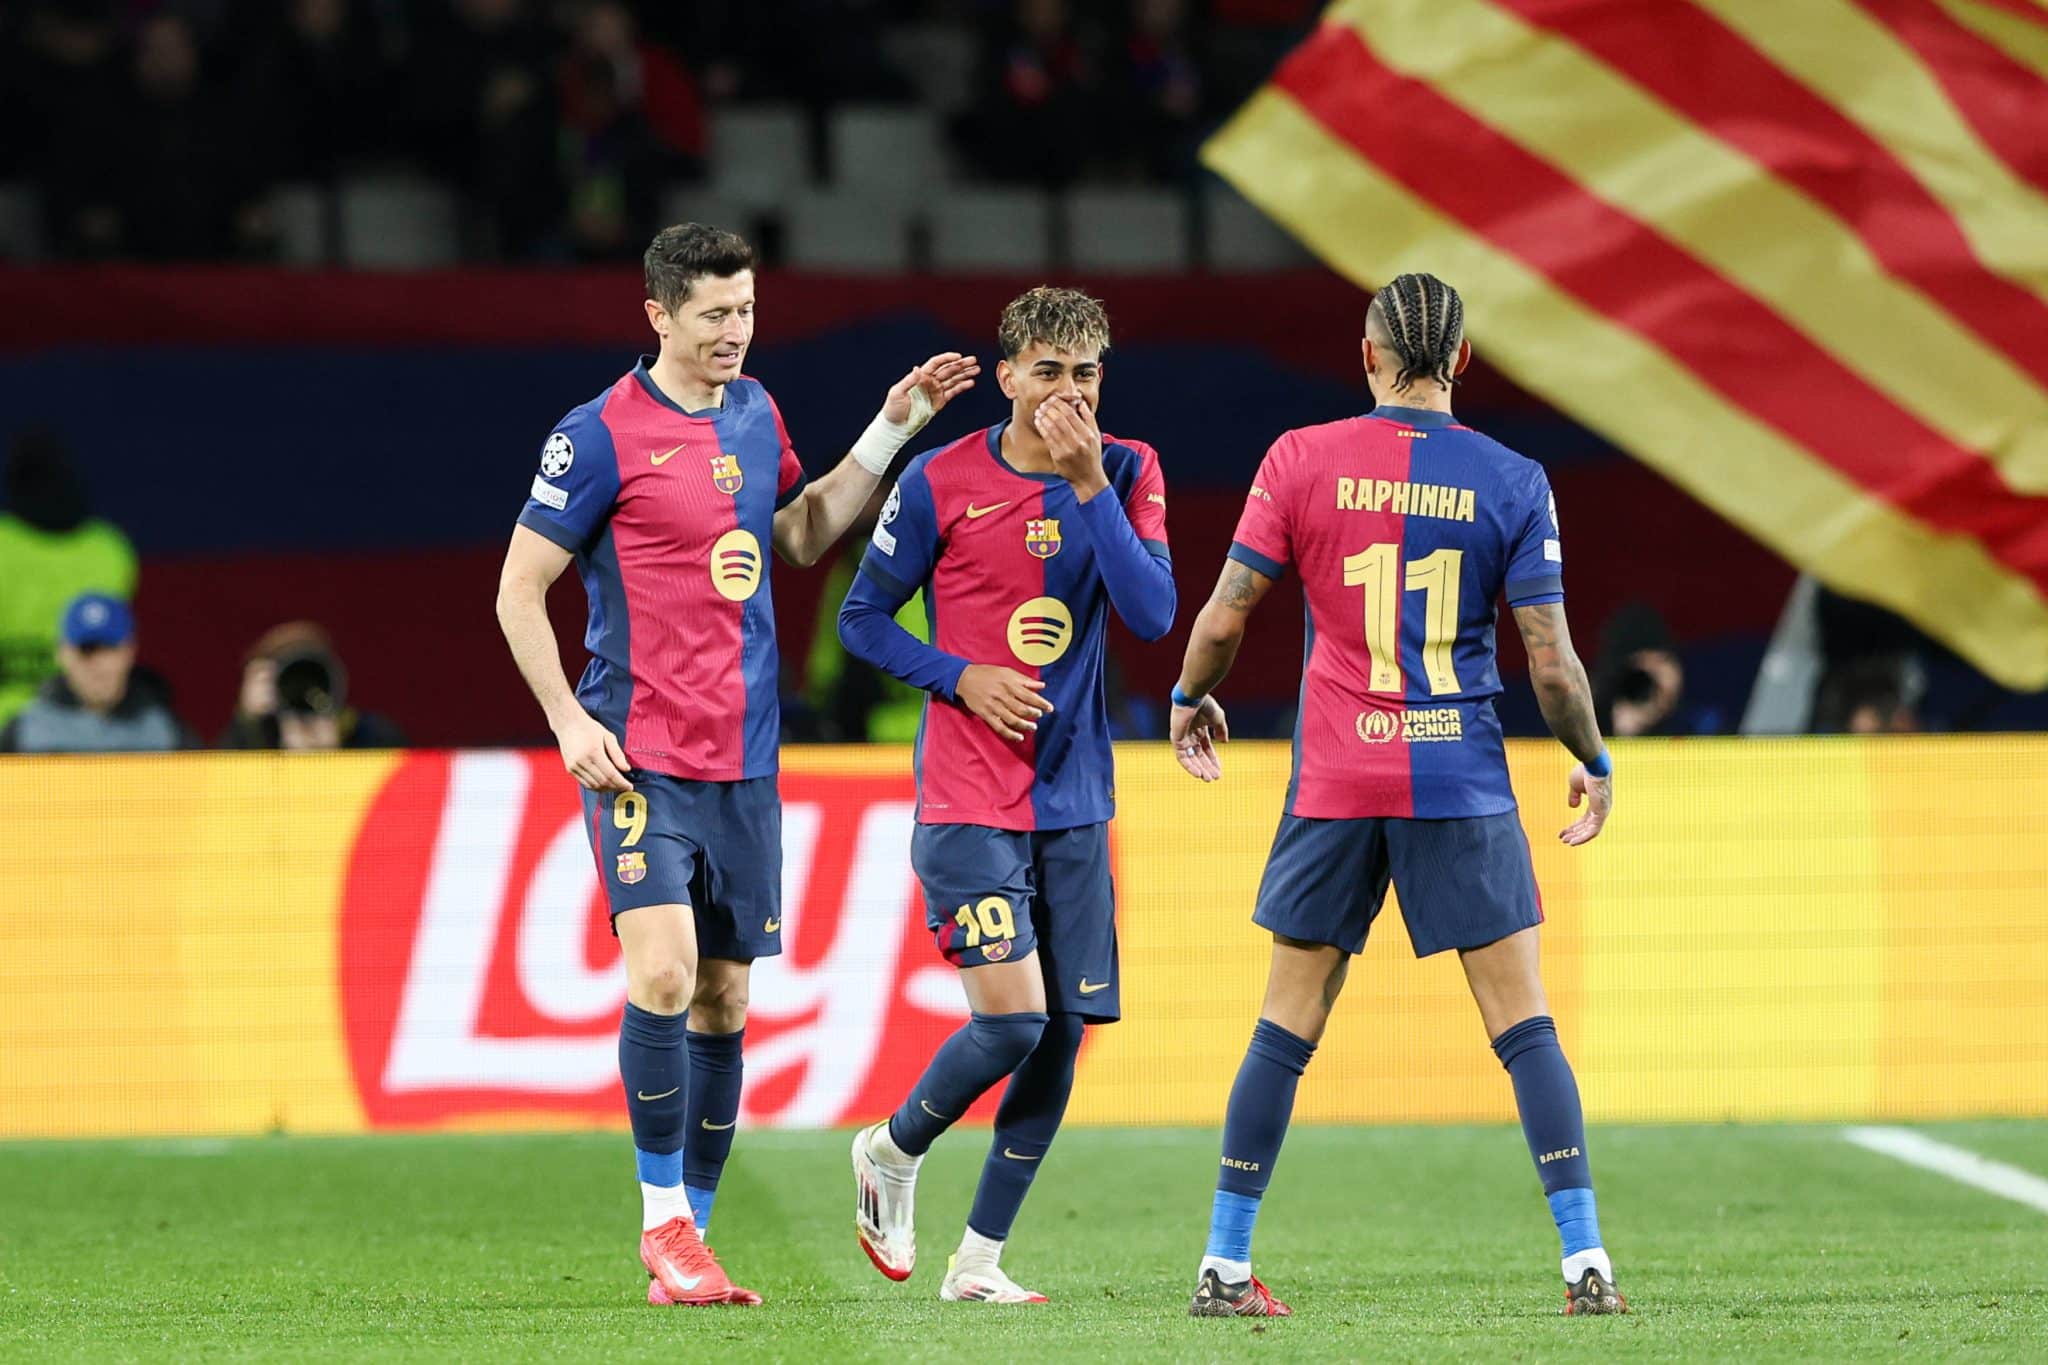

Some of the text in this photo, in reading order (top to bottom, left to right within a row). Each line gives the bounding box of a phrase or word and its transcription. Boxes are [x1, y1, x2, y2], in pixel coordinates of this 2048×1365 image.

[1336, 477, 1475, 522] RAPHINHA
[1343, 543, 1464, 696] 11
[1400, 710, 1460, 723] UNHCR
[1402, 722, 1462, 736] ACNUR
[614, 791, 648, 848] 9
[383, 752, 966, 1128] Lay
[955, 896, 1017, 947] 19
